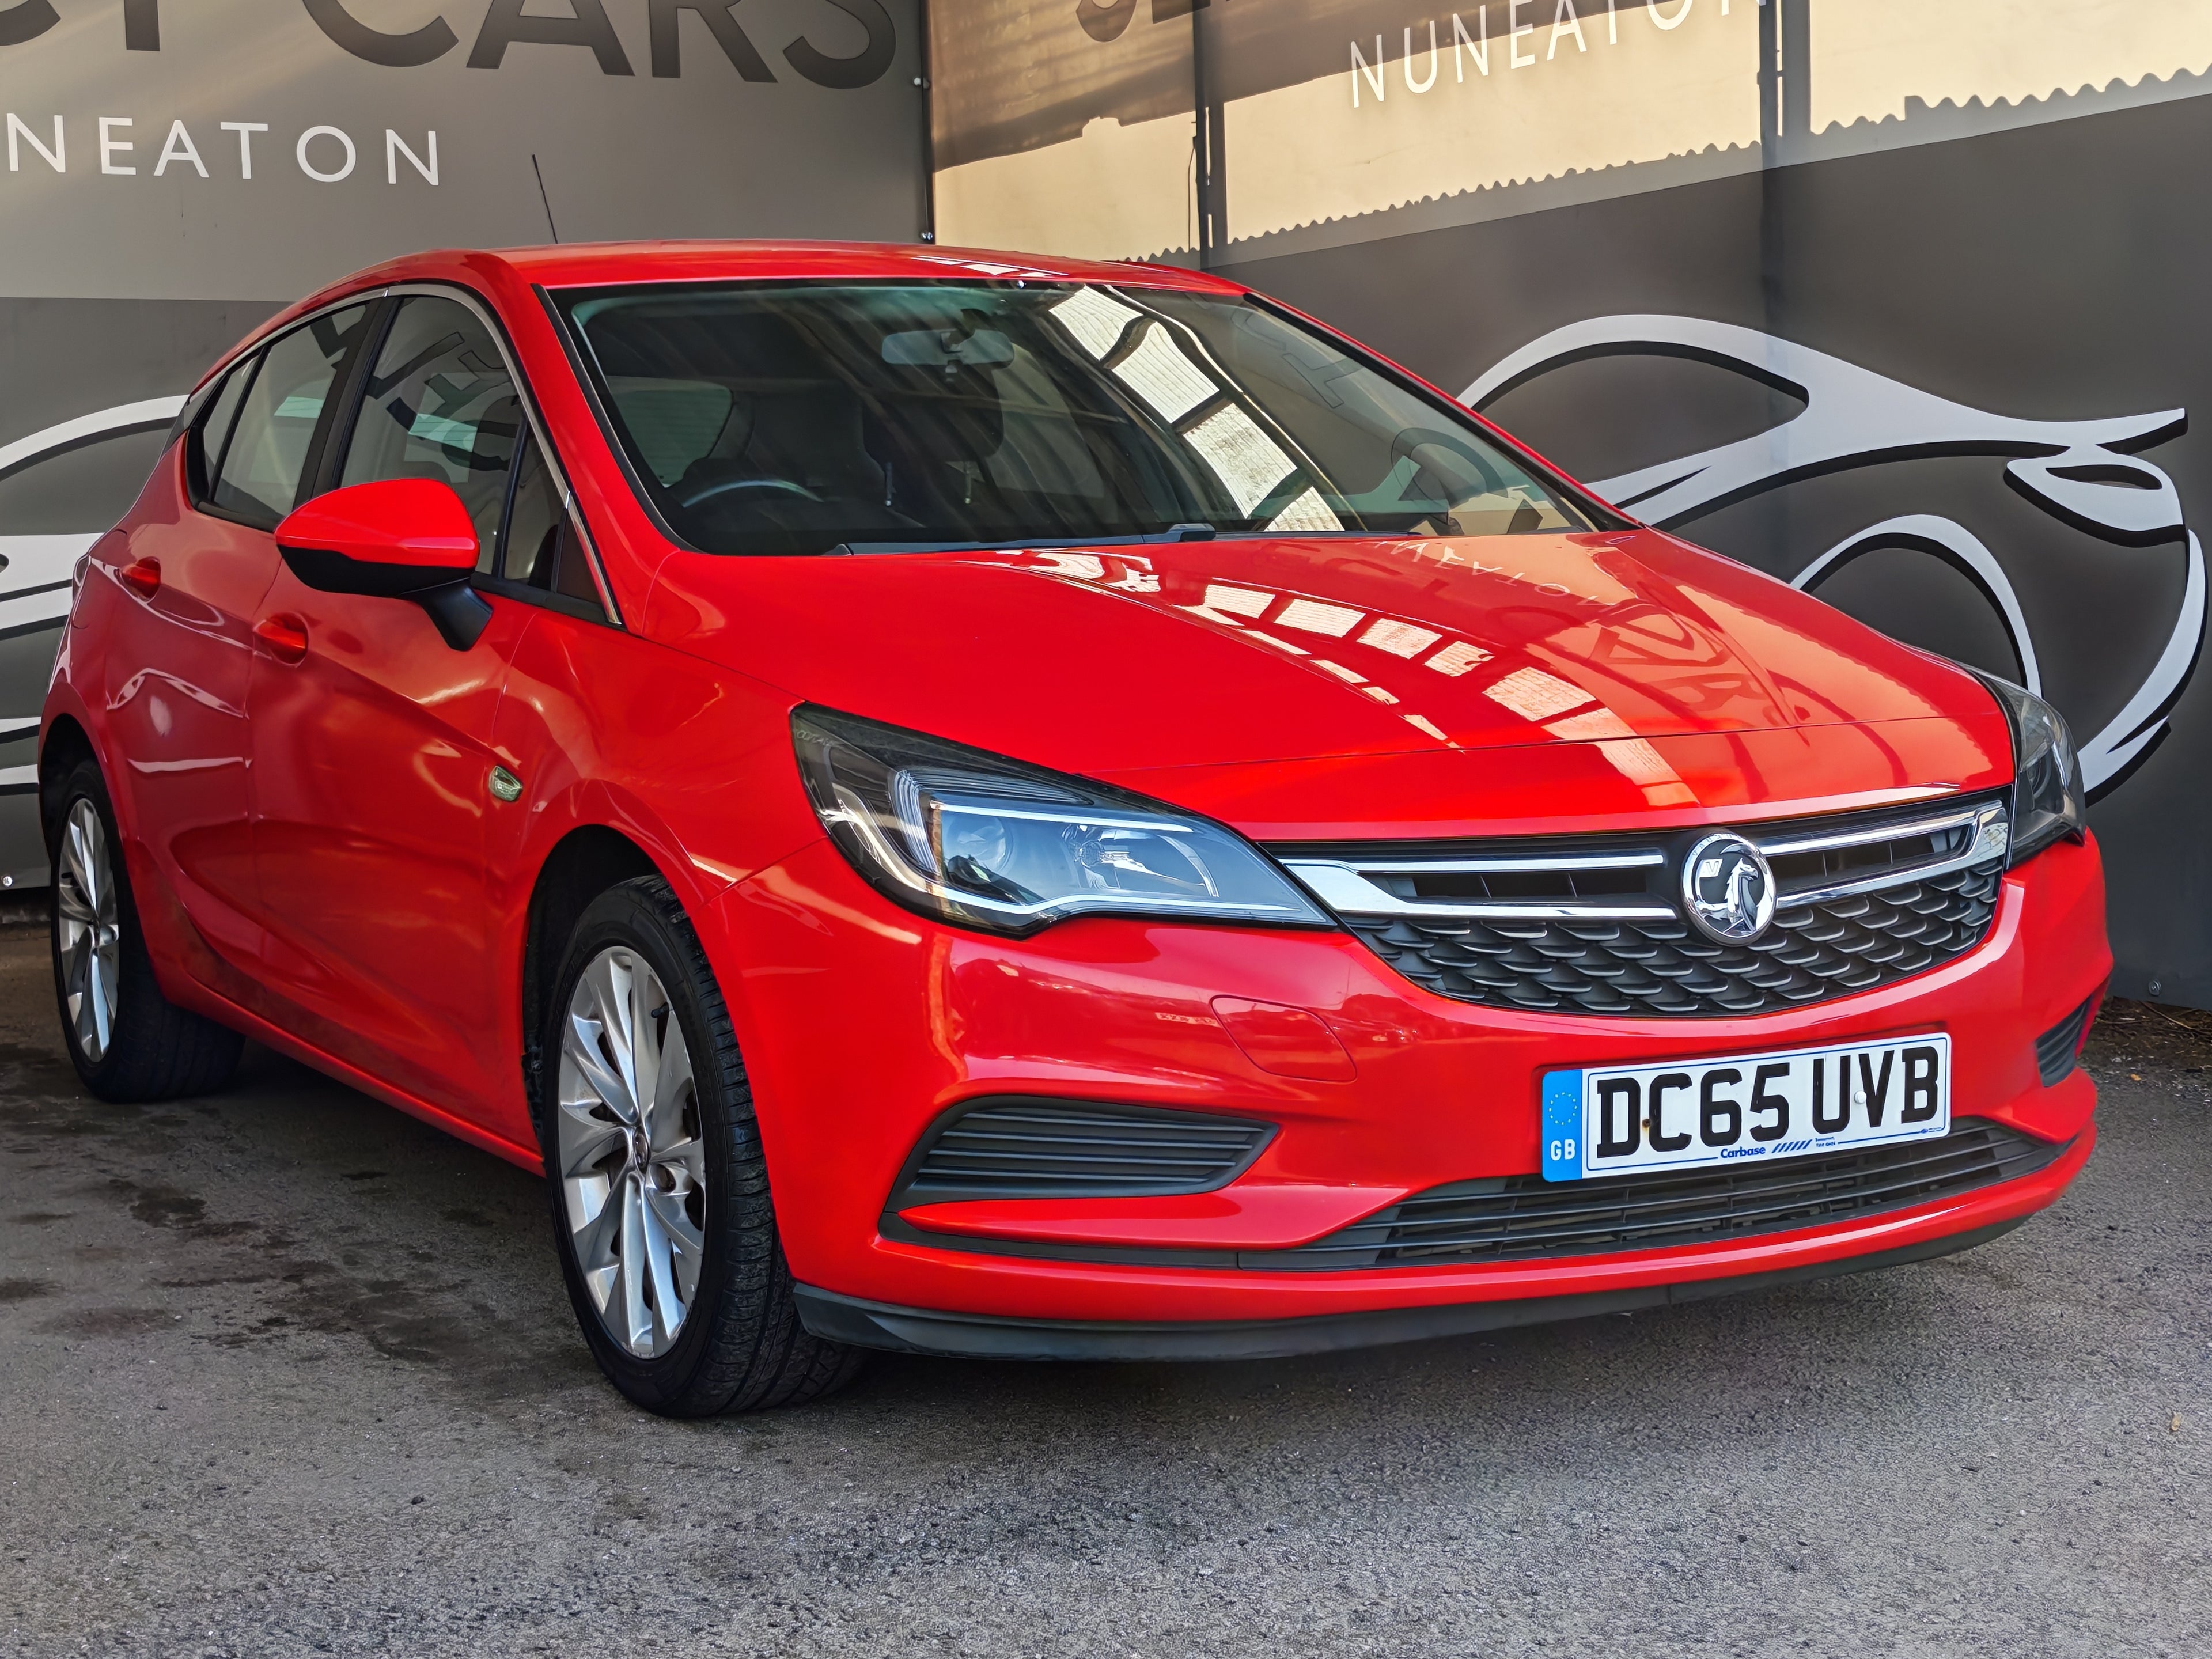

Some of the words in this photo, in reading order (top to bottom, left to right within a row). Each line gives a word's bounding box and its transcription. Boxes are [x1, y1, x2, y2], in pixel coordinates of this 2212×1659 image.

[1350, 0, 1766, 108] NUNEA
[7, 113, 440, 186] NEATON
[1596, 1063, 1790, 1158] DC65
[1812, 1046, 1938, 1135] UVB
[1550, 1138, 1576, 1161] GB
[1720, 1146, 1766, 1158] Carbase
